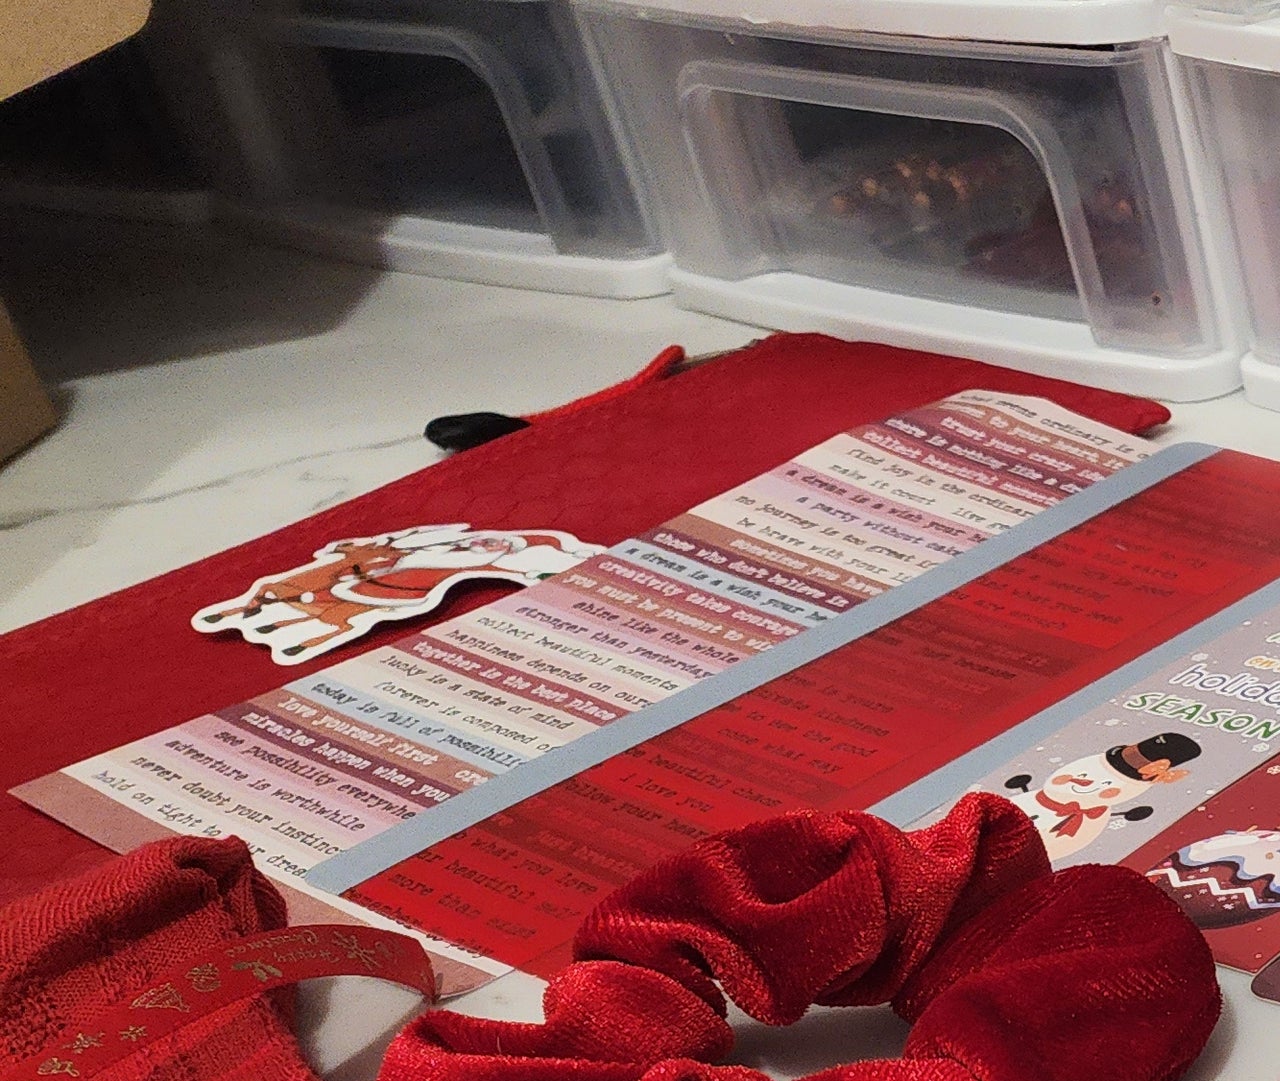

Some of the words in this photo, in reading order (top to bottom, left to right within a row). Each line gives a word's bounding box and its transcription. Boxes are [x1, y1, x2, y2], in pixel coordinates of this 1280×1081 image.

[735, 495, 756, 506] no
[755, 503, 820, 530] journey
[866, 544, 916, 564] great
[737, 517, 756, 528] be
[758, 526, 805, 547] brave
[809, 544, 845, 562] with
[849, 558, 889, 577] your
[810, 501, 860, 523] party
[863, 519, 925, 545] without
[640, 551, 688, 573] dream
[726, 582, 762, 601] wish
[760, 596, 805, 615] your
[653, 532, 695, 552] those
[696, 549, 728, 565] who
[768, 573, 827, 599] believe
[730, 538, 808, 570] sometimes
[806, 565, 840, 582] you
[515, 605, 590, 634] stronger
[589, 631, 628, 648] than
[563, 574, 598, 589] you
[599, 585, 640, 605] must
[637, 599, 660, 612] be
[656, 608, 723, 635] present
[723, 629, 744, 642] to
[599, 561, 686, 598] creativity
[685, 591, 732, 613] takes
[731, 608, 800, 637] courage
[446, 629, 525, 664] happiness
[526, 657, 588, 685] depends
[588, 681, 612, 693] on
[477, 616, 536, 641] collect
[540, 636, 608, 667] beautiful
[611, 662, 681, 692] moments
[573, 600, 620, 622] shine
[622, 617, 658, 635] like
[661, 631, 690, 646] the
[693, 642, 740, 664] whole
[311, 681, 358, 704] today
[357, 701, 376, 714] is
[379, 710, 420, 730] full
[418, 725, 445, 737] of
[373, 681, 439, 709] forever
[440, 705, 461, 718] is
[461, 714, 540, 746] composed
[381, 654, 427, 678] lucky
[432, 674, 448, 685] is
[447, 683, 462, 692] a
[463, 688, 507, 708] state
[507, 703, 533, 715] of
[528, 712, 576, 732] mind
[413, 640, 482, 672] together
[480, 667, 501, 679] is
[502, 674, 531, 691] the
[531, 685, 570, 704] best
[564, 697, 617, 723] place
[213, 731, 245, 748] see
[240, 744, 339, 788] possibility
[241, 711, 317, 748] miracles
[312, 739, 374, 770] happen
[372, 763, 416, 789] when
[411, 782, 452, 804] you
[277, 696, 318, 718] love
[311, 713, 394, 749] yourself
[388, 739, 439, 767] first
[762, 743, 805, 761] what
[92, 769, 135, 793] hold
[132, 791, 155, 806] on
[157, 801, 203, 829] tight
[202, 823, 225, 837] to
[130, 756, 184, 783] never
[182, 781, 232, 808] doubt
[224, 802, 275, 825] your
[164, 739, 249, 783] adventure
[246, 778, 272, 791] is
[271, 786, 368, 833] worthwhile
[636, 777, 677, 799] love
[675, 796, 716, 813] you
[651, 753, 732, 790] beautiful
[612, 801, 663, 821] your
[387, 872, 435, 898] more
[437, 892, 483, 921] than
[444, 858, 536, 902] beautiful
[470, 837, 519, 862] what
[513, 858, 554, 878] you
[555, 872, 599, 896] love
